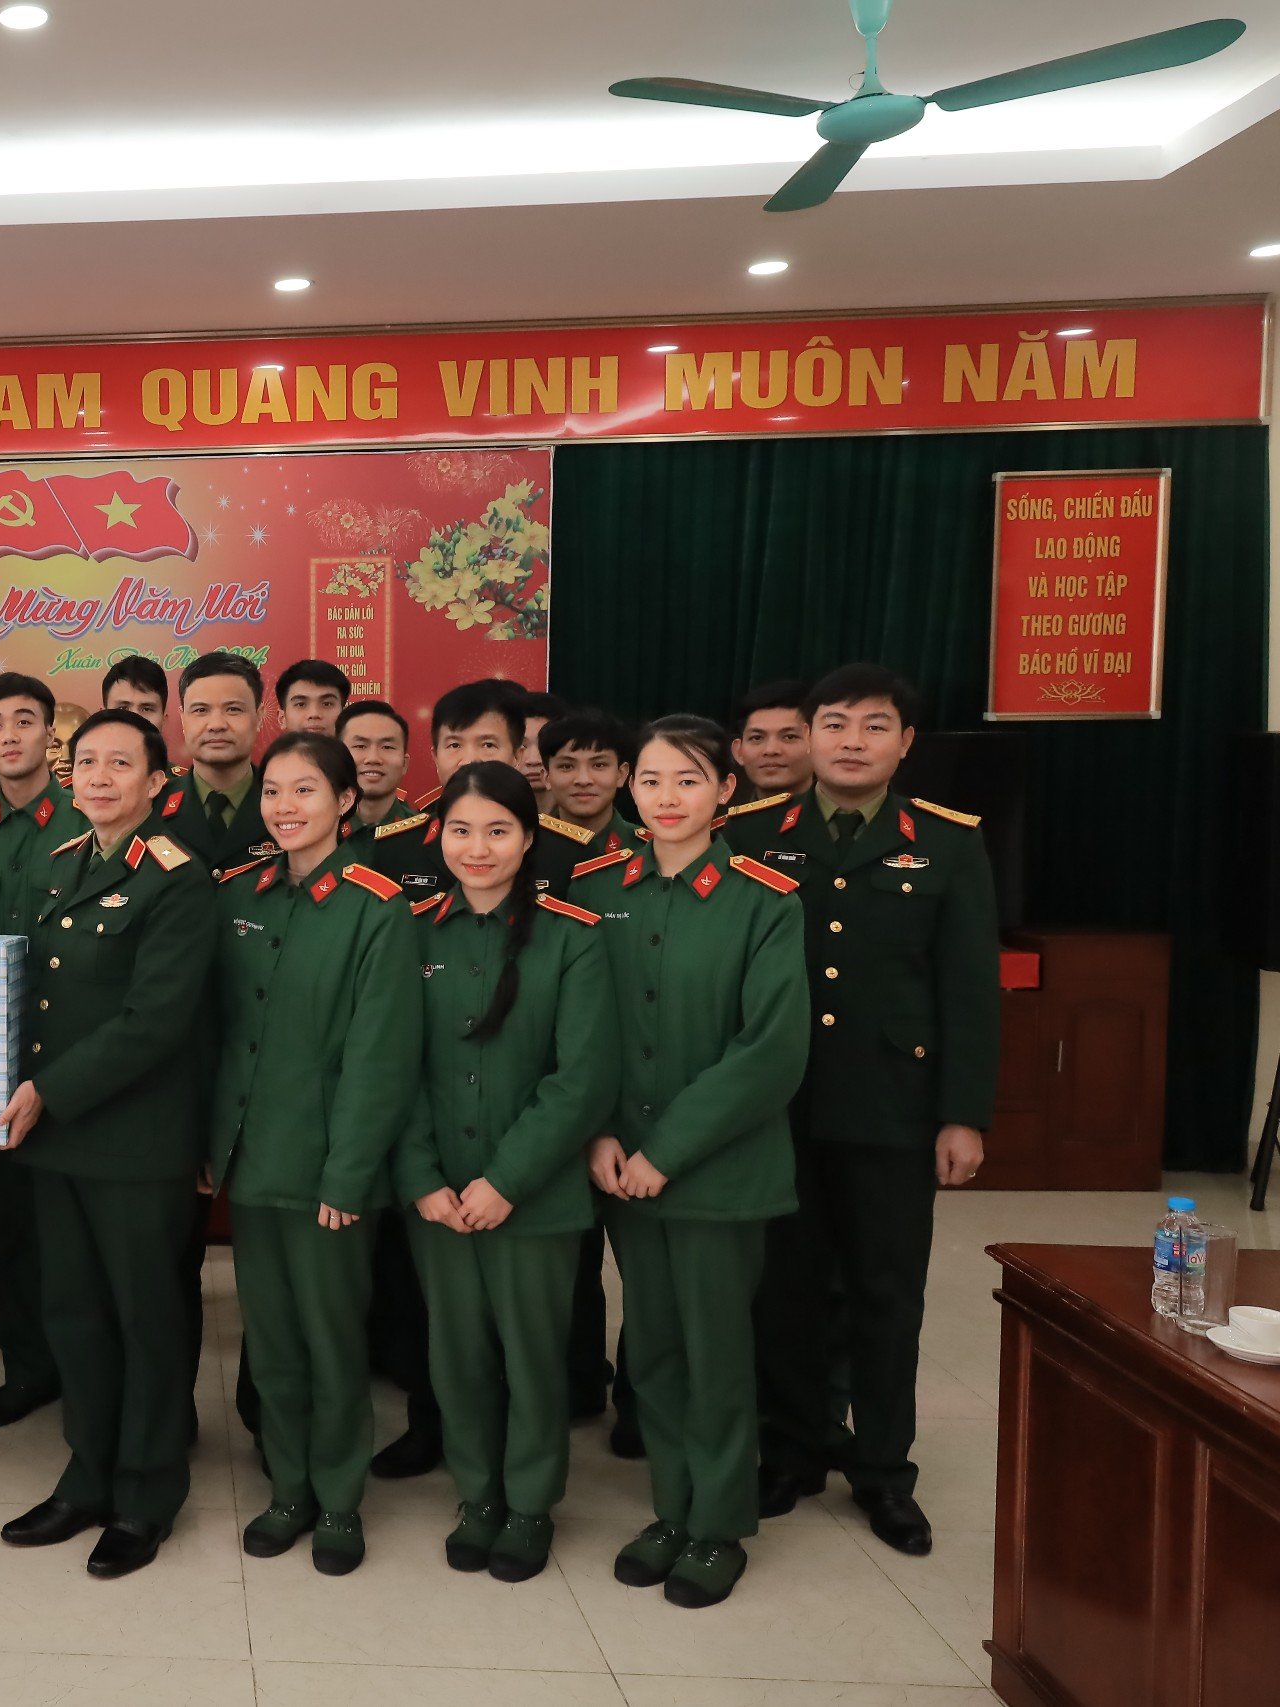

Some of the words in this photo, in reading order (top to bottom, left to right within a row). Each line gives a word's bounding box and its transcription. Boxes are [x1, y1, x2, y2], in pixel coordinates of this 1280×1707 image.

[141, 362, 398, 432] QUANG
[438, 355, 618, 418] VINH
[665, 336, 904, 412] MUÔN
[943, 330, 1137, 403] NĂM
[1006, 492, 1057, 522] SỐNG,
[1063, 489, 1115, 520] CHIẾN
[1120, 488, 1153, 518] ĐẤU
[1035, 537, 1067, 559] LAO
[1072, 531, 1121, 563] ĐỘNG
[1028, 571, 1048, 598] VÀ
[1054, 575, 1088, 602] HỌC
[1096, 570, 1128, 601] TẬP
[95, 575, 200, 638] Năm
[327, 605, 343, 621] BÁC
[337, 627, 347, 639] RA
[349, 624, 364, 639] SỨC
[1021, 614, 1063, 637] THEO
[1068, 612, 1127, 636] GƯƠNG
[47, 646, 102, 676] Xuân
[336, 645, 348, 658] THI
[1019, 648, 1052, 675] BÁC
[1055, 646, 1078, 675] HỒ
[1083, 648, 1100, 674] VĨ
[1103, 651, 1132, 678] ĐẠI
